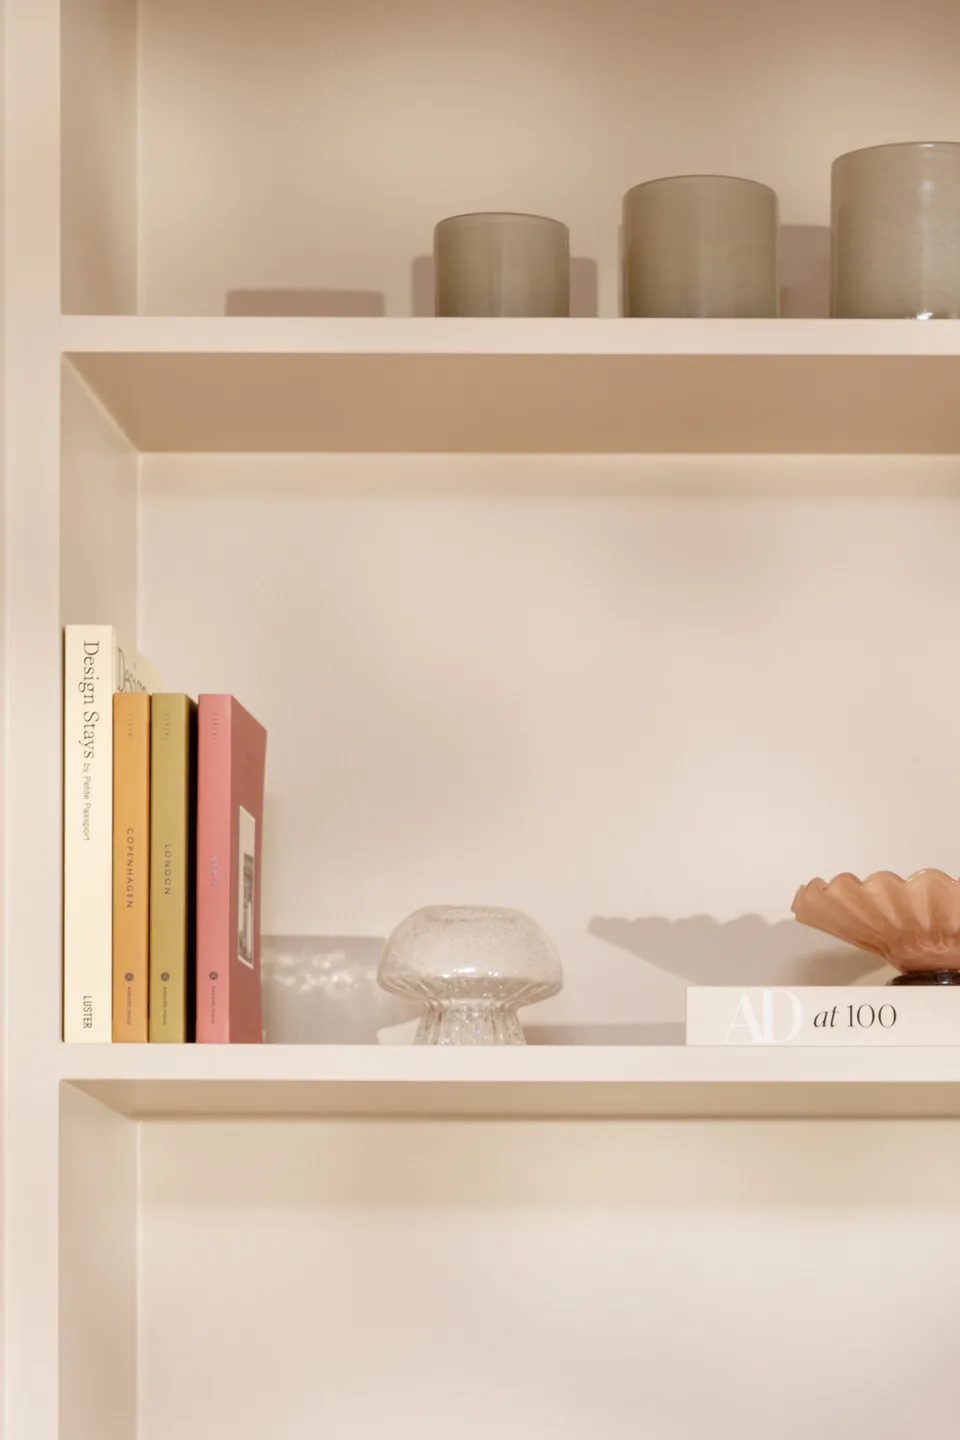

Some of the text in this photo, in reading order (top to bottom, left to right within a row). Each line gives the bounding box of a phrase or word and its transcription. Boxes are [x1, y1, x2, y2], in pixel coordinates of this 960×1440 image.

[78, 640, 100, 841] Design Stays by Petite Passport
[126, 827, 134, 908] COPENHAGEN
[83, 995, 93, 1029] LUSTER
[719, 988, 897, 1044] AD at 100
